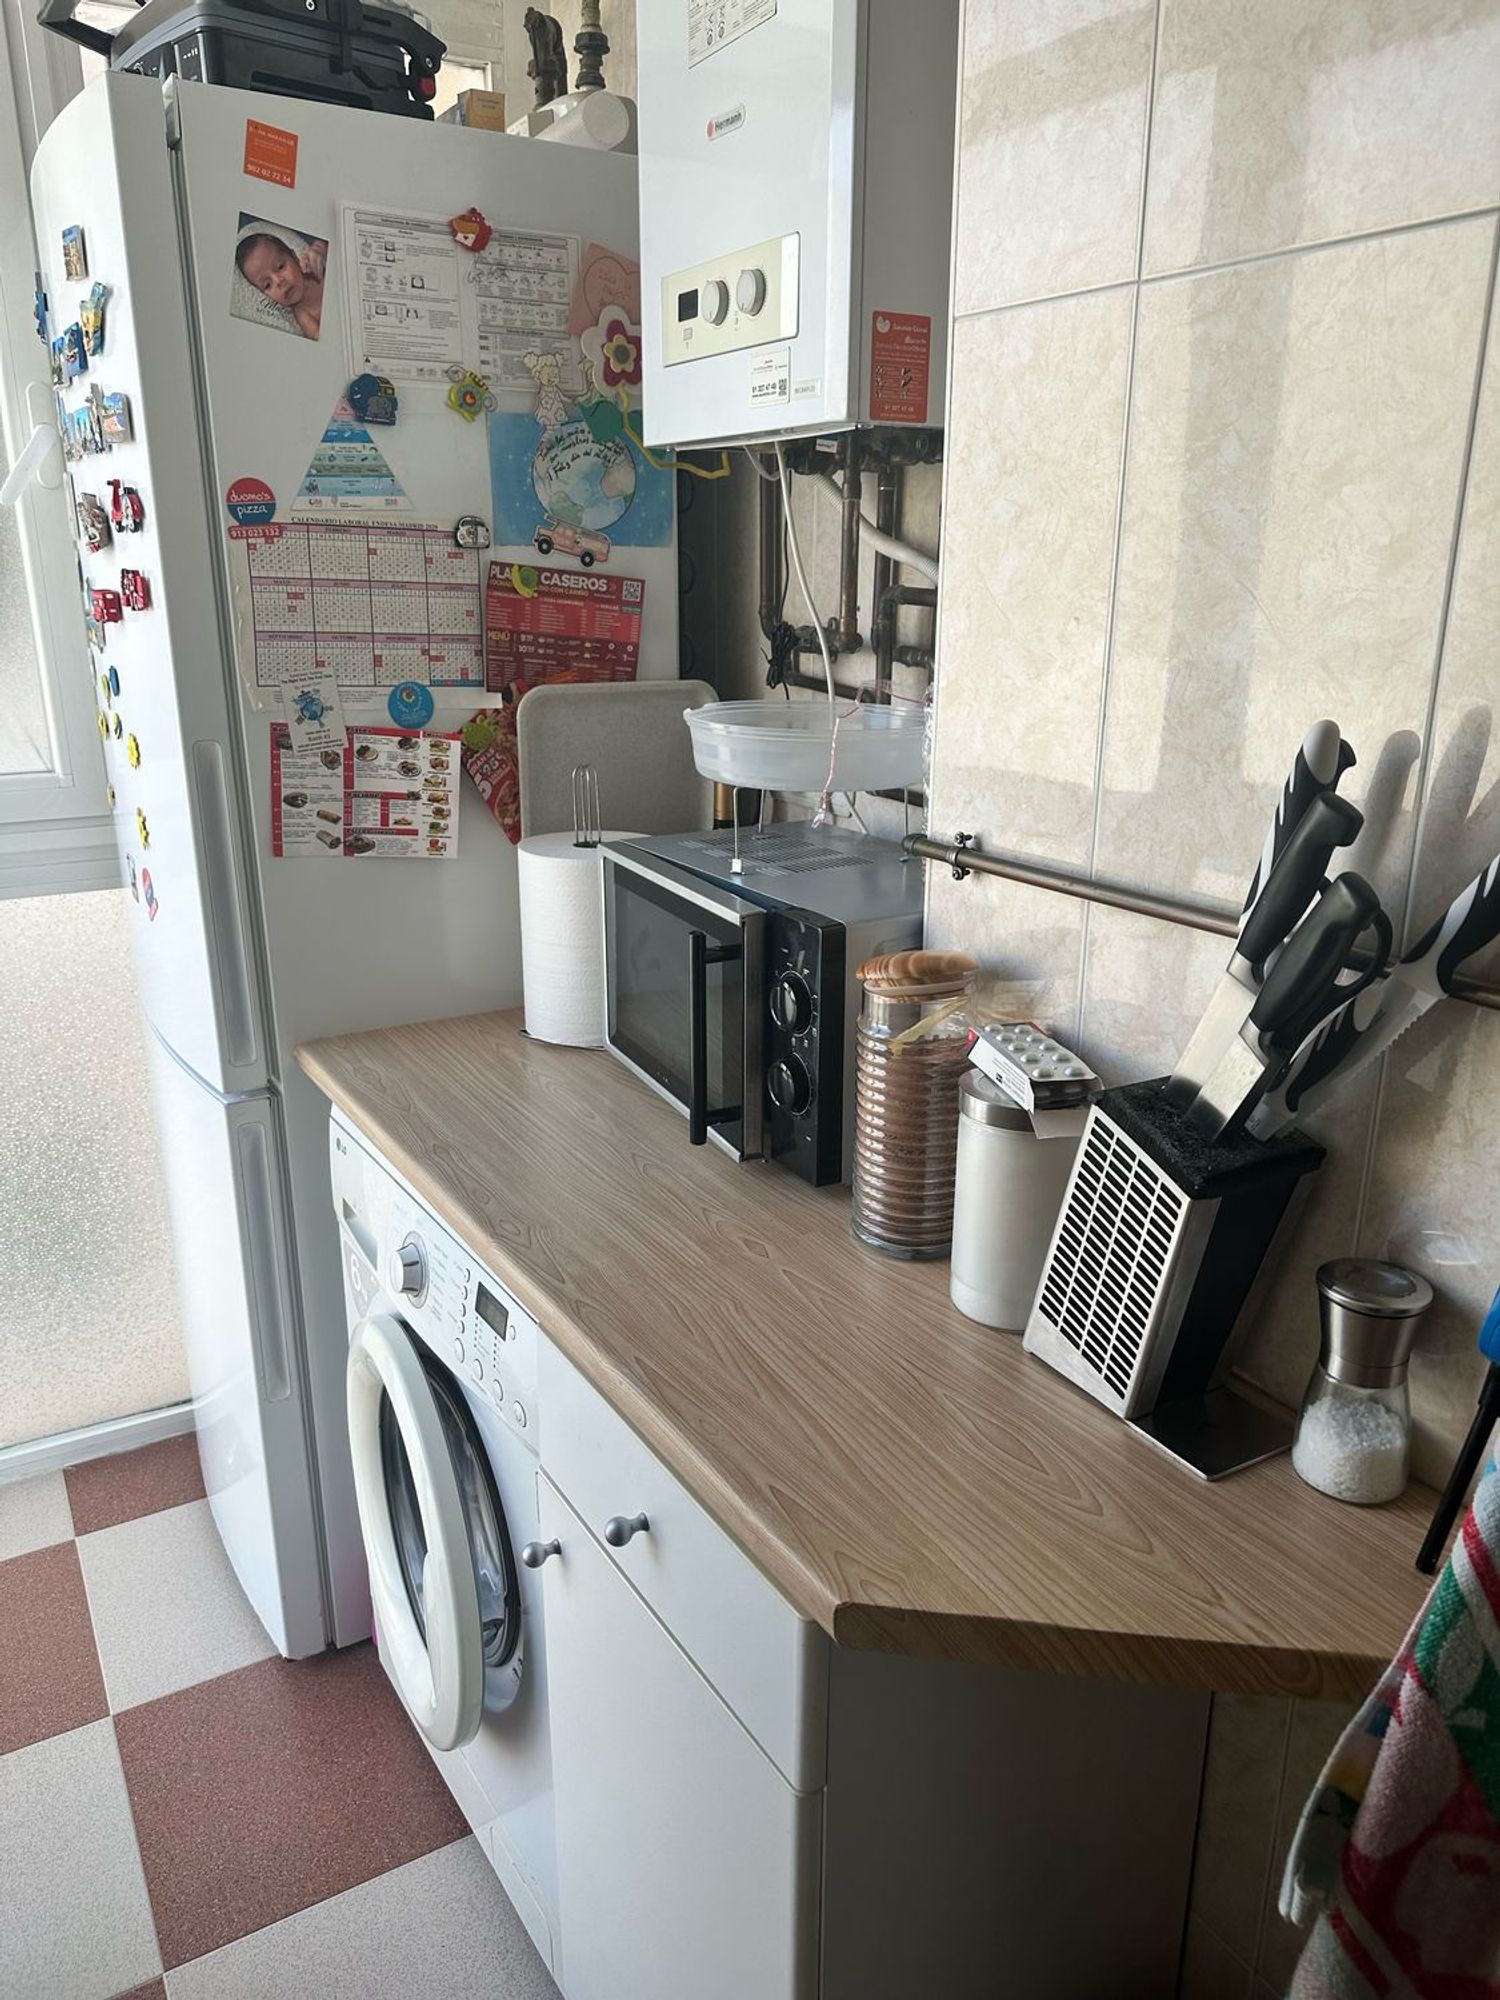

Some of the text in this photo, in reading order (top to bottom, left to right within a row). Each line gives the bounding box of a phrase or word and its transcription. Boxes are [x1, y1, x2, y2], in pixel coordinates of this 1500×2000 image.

[230, 490, 271, 502] duomo's
[237, 505, 268, 520] pizza
[541, 571, 608, 592] CASEROS
